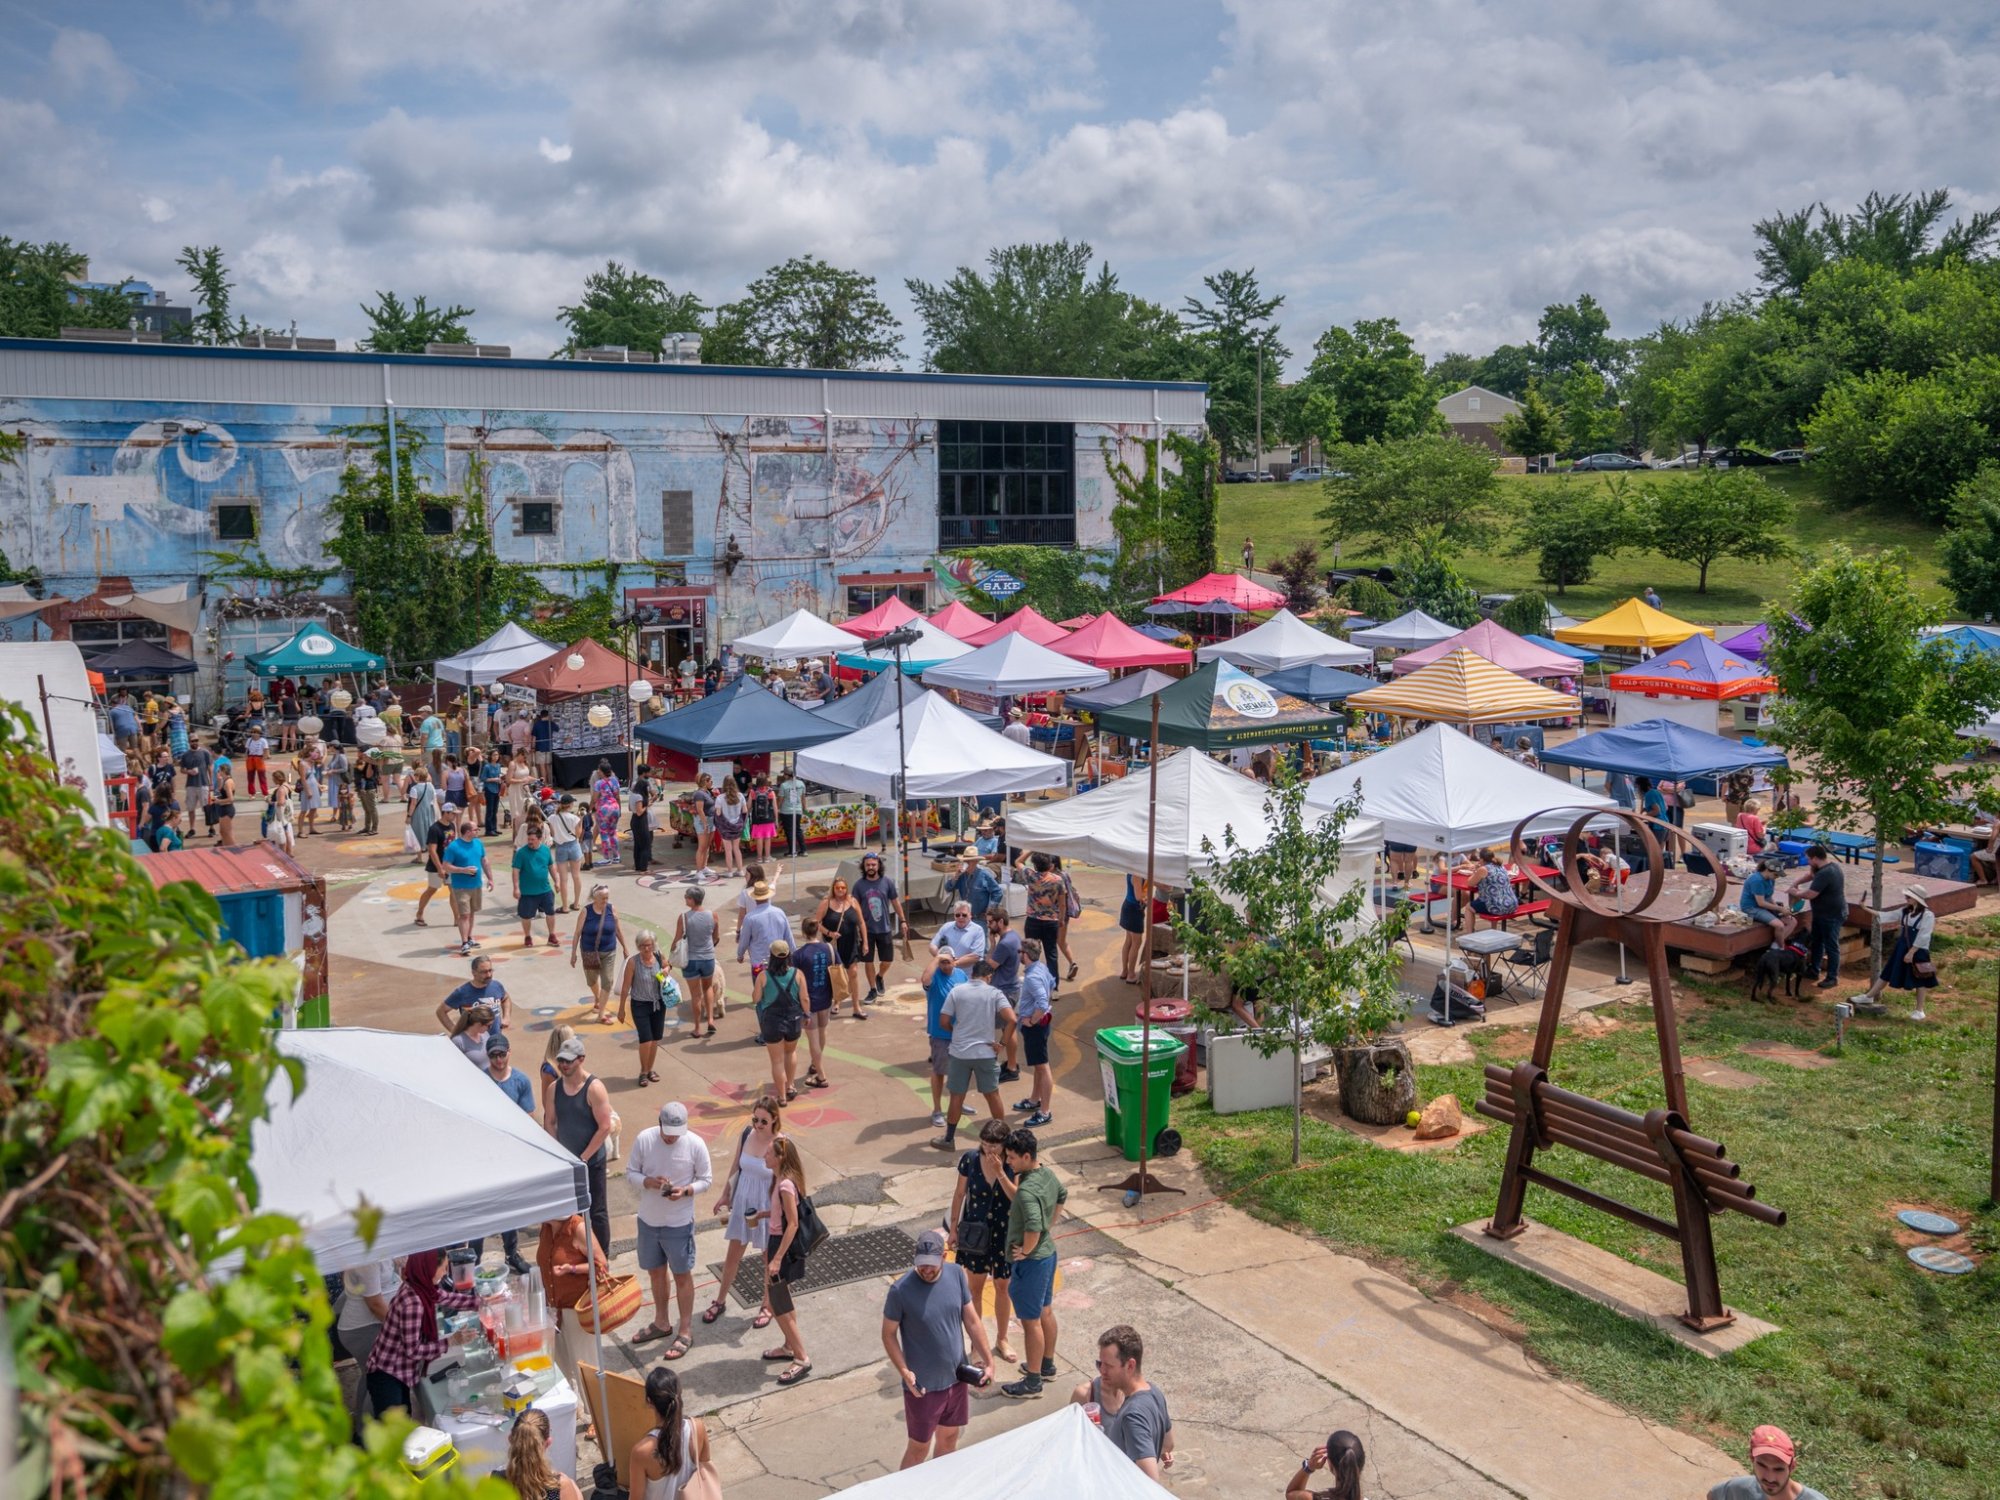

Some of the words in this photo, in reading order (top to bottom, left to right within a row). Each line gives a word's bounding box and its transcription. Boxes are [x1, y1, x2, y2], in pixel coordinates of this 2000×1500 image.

[983, 582, 1020, 590] SAKE
[1640, 680, 1674, 689] COUNTRY
[1676, 683, 1708, 693] SALMON
[1236, 701, 1276, 711] ALBEMARLE
